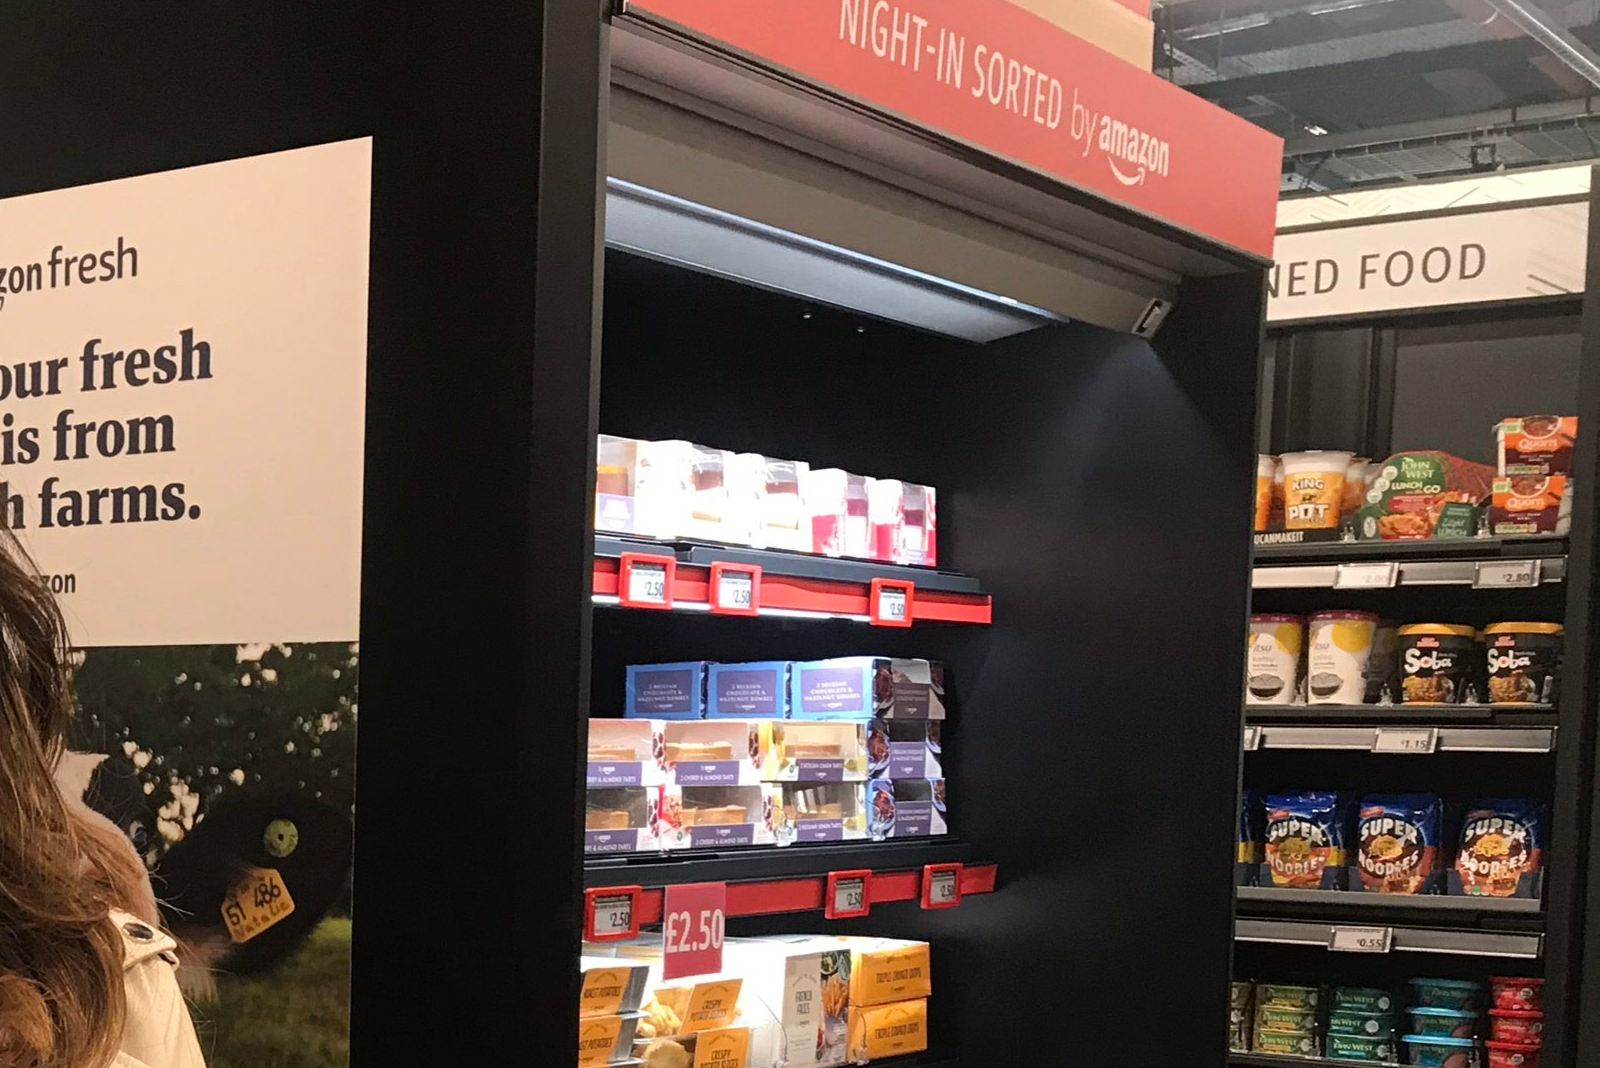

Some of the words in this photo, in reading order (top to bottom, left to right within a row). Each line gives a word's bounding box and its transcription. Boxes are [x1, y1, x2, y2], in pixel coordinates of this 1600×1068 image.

[838, 0, 965, 90] NIGHT-IN
[971, 43, 1063, 130] SORTED
[1070, 87, 1098, 157] by
[1098, 114, 1170, 178] amazon
[1358, 242, 1487, 291] FOOD
[79, 328, 214, 392] fresh
[0, 412, 41, 466] is
[52, 408, 176, 463] from
[1518, 438, 1558, 453] Quorn
[1401, 460, 1430, 472] JOHN
[1406, 468, 1435, 479] WEST
[1291, 478, 1325, 492] KING
[1391, 481, 1424, 491] LUNCH
[1423, 484, 1442, 494] GO
[37, 476, 203, 529] farms.
[1287, 503, 1330, 521] POT
[1506, 497, 1545, 511] Quorn
[1503, 572, 1531, 583] £2.80
[1252, 642, 1273, 653] itsu
[1404, 648, 1453, 672] Soba
[1487, 648, 1531, 674] Soba
[1401, 739, 1427, 750] £1.15
[1269, 820, 1325, 846] SUPER
[1359, 816, 1418, 844] SUPER
[1464, 819, 1527, 843] SUPER
[1357, 850, 1419, 876] NOODLES
[253, 876, 282, 909] 486
[609, 910, 631, 930] £2.50
[665, 907, 725, 955] £2.50
[1356, 937, 1382, 948] £0.55
[710, 1049, 732, 1061] CRISPY
[1352, 1043, 1374, 1052] WEST
